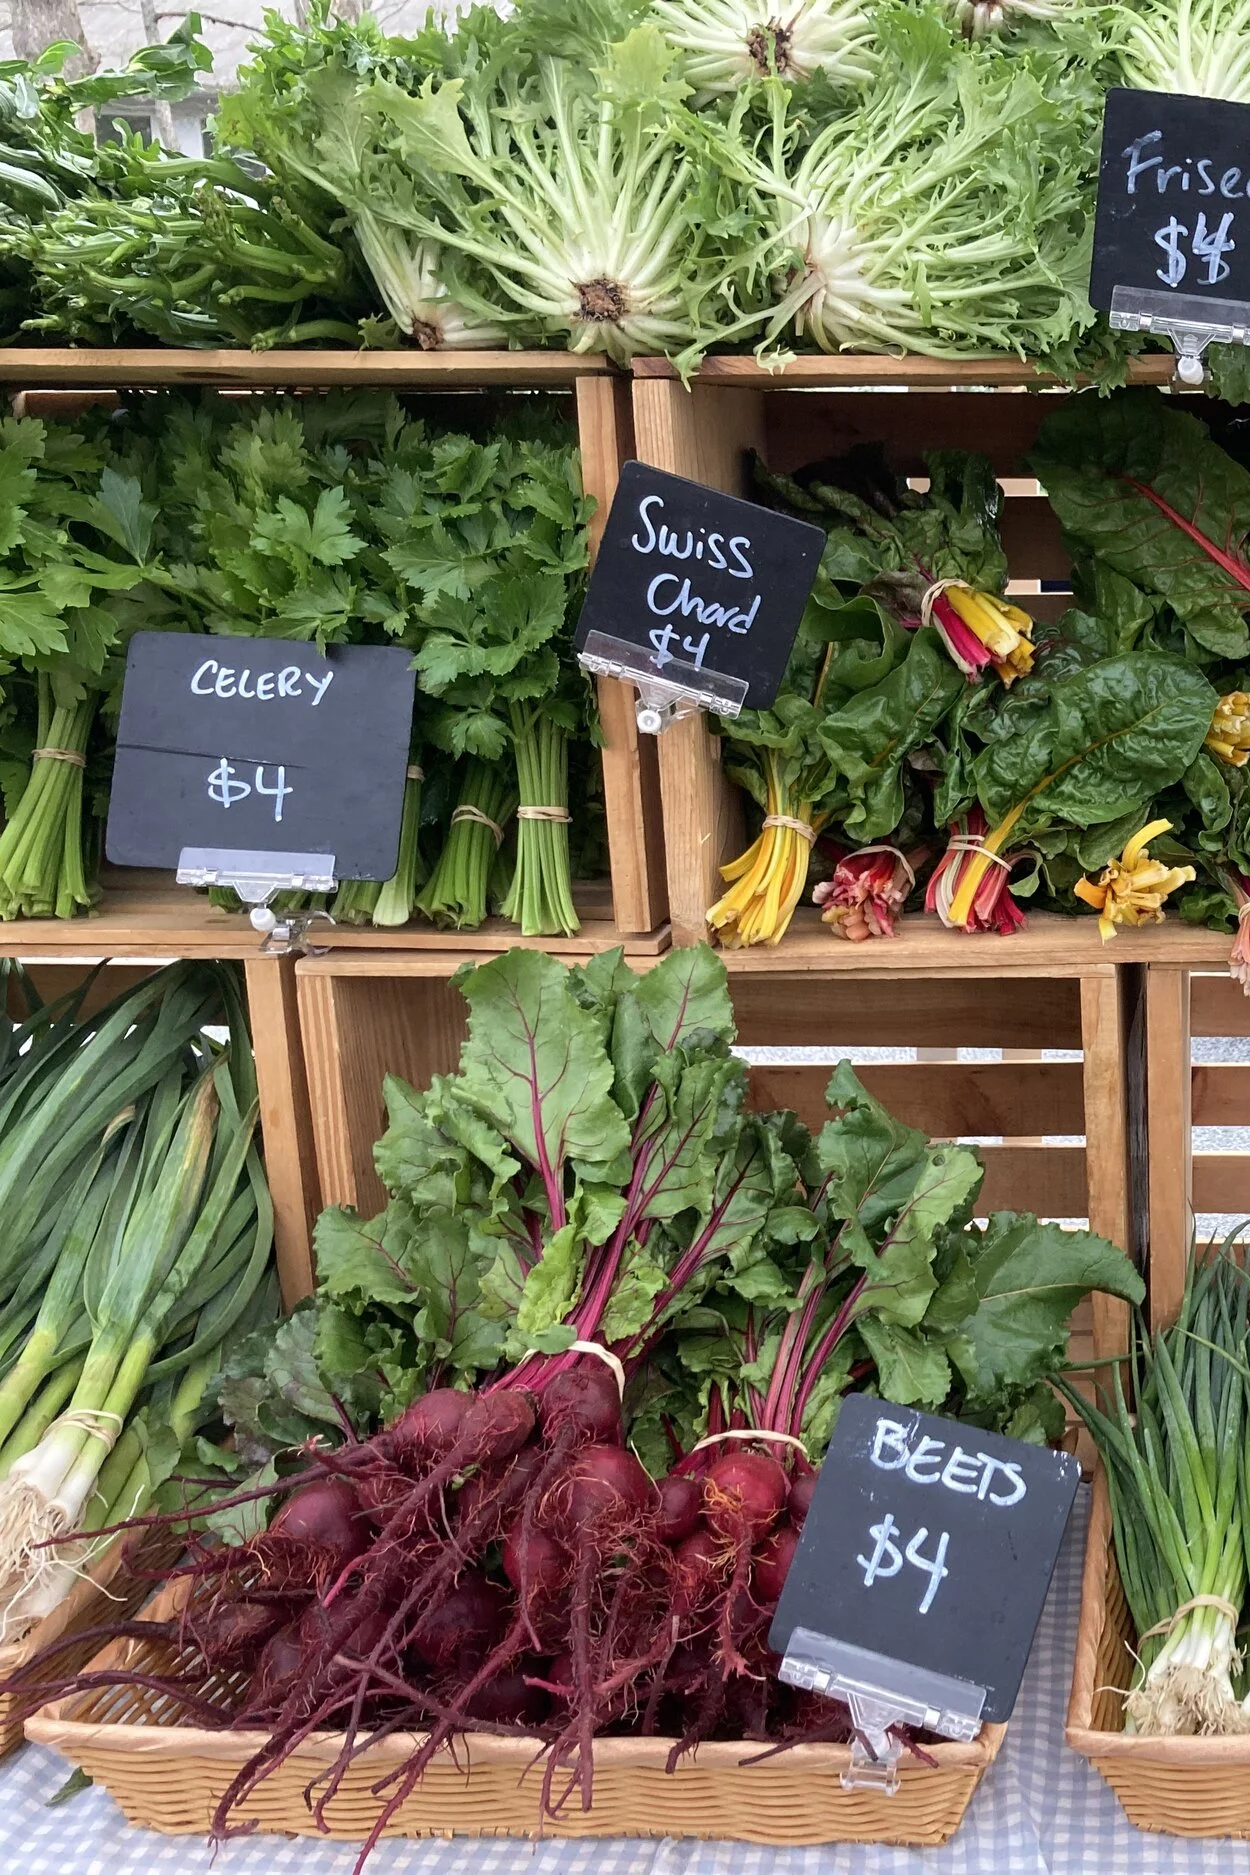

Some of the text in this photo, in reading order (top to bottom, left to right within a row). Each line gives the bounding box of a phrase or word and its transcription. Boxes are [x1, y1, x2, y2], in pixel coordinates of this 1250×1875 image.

[1154, 212, 1236, 288] $4
[631, 495, 754, 579] Swiss
[646, 573, 761, 634] Chard
[649, 623, 710, 671] $4
[190, 659, 334, 706] CELERY
[207, 757, 293, 822] $4
[869, 1416, 1027, 1506] BEETS
[856, 1513, 950, 1614] $4
